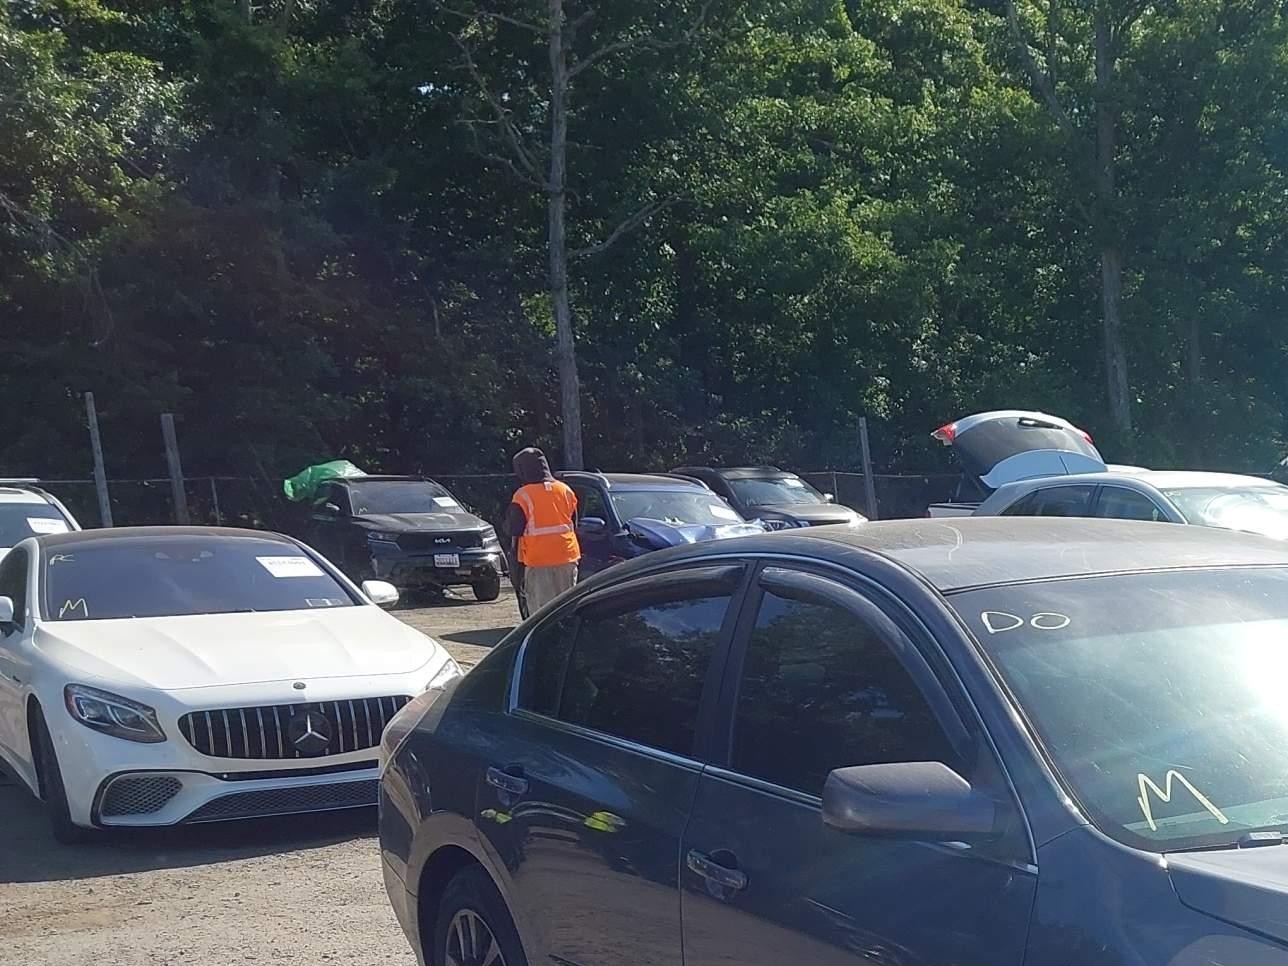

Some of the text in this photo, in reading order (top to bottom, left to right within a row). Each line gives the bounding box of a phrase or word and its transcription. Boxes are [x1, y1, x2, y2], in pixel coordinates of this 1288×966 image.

[59, 597, 89, 618] M
[981, 611, 1071, 634] DO
[1137, 769, 1229, 832] M
